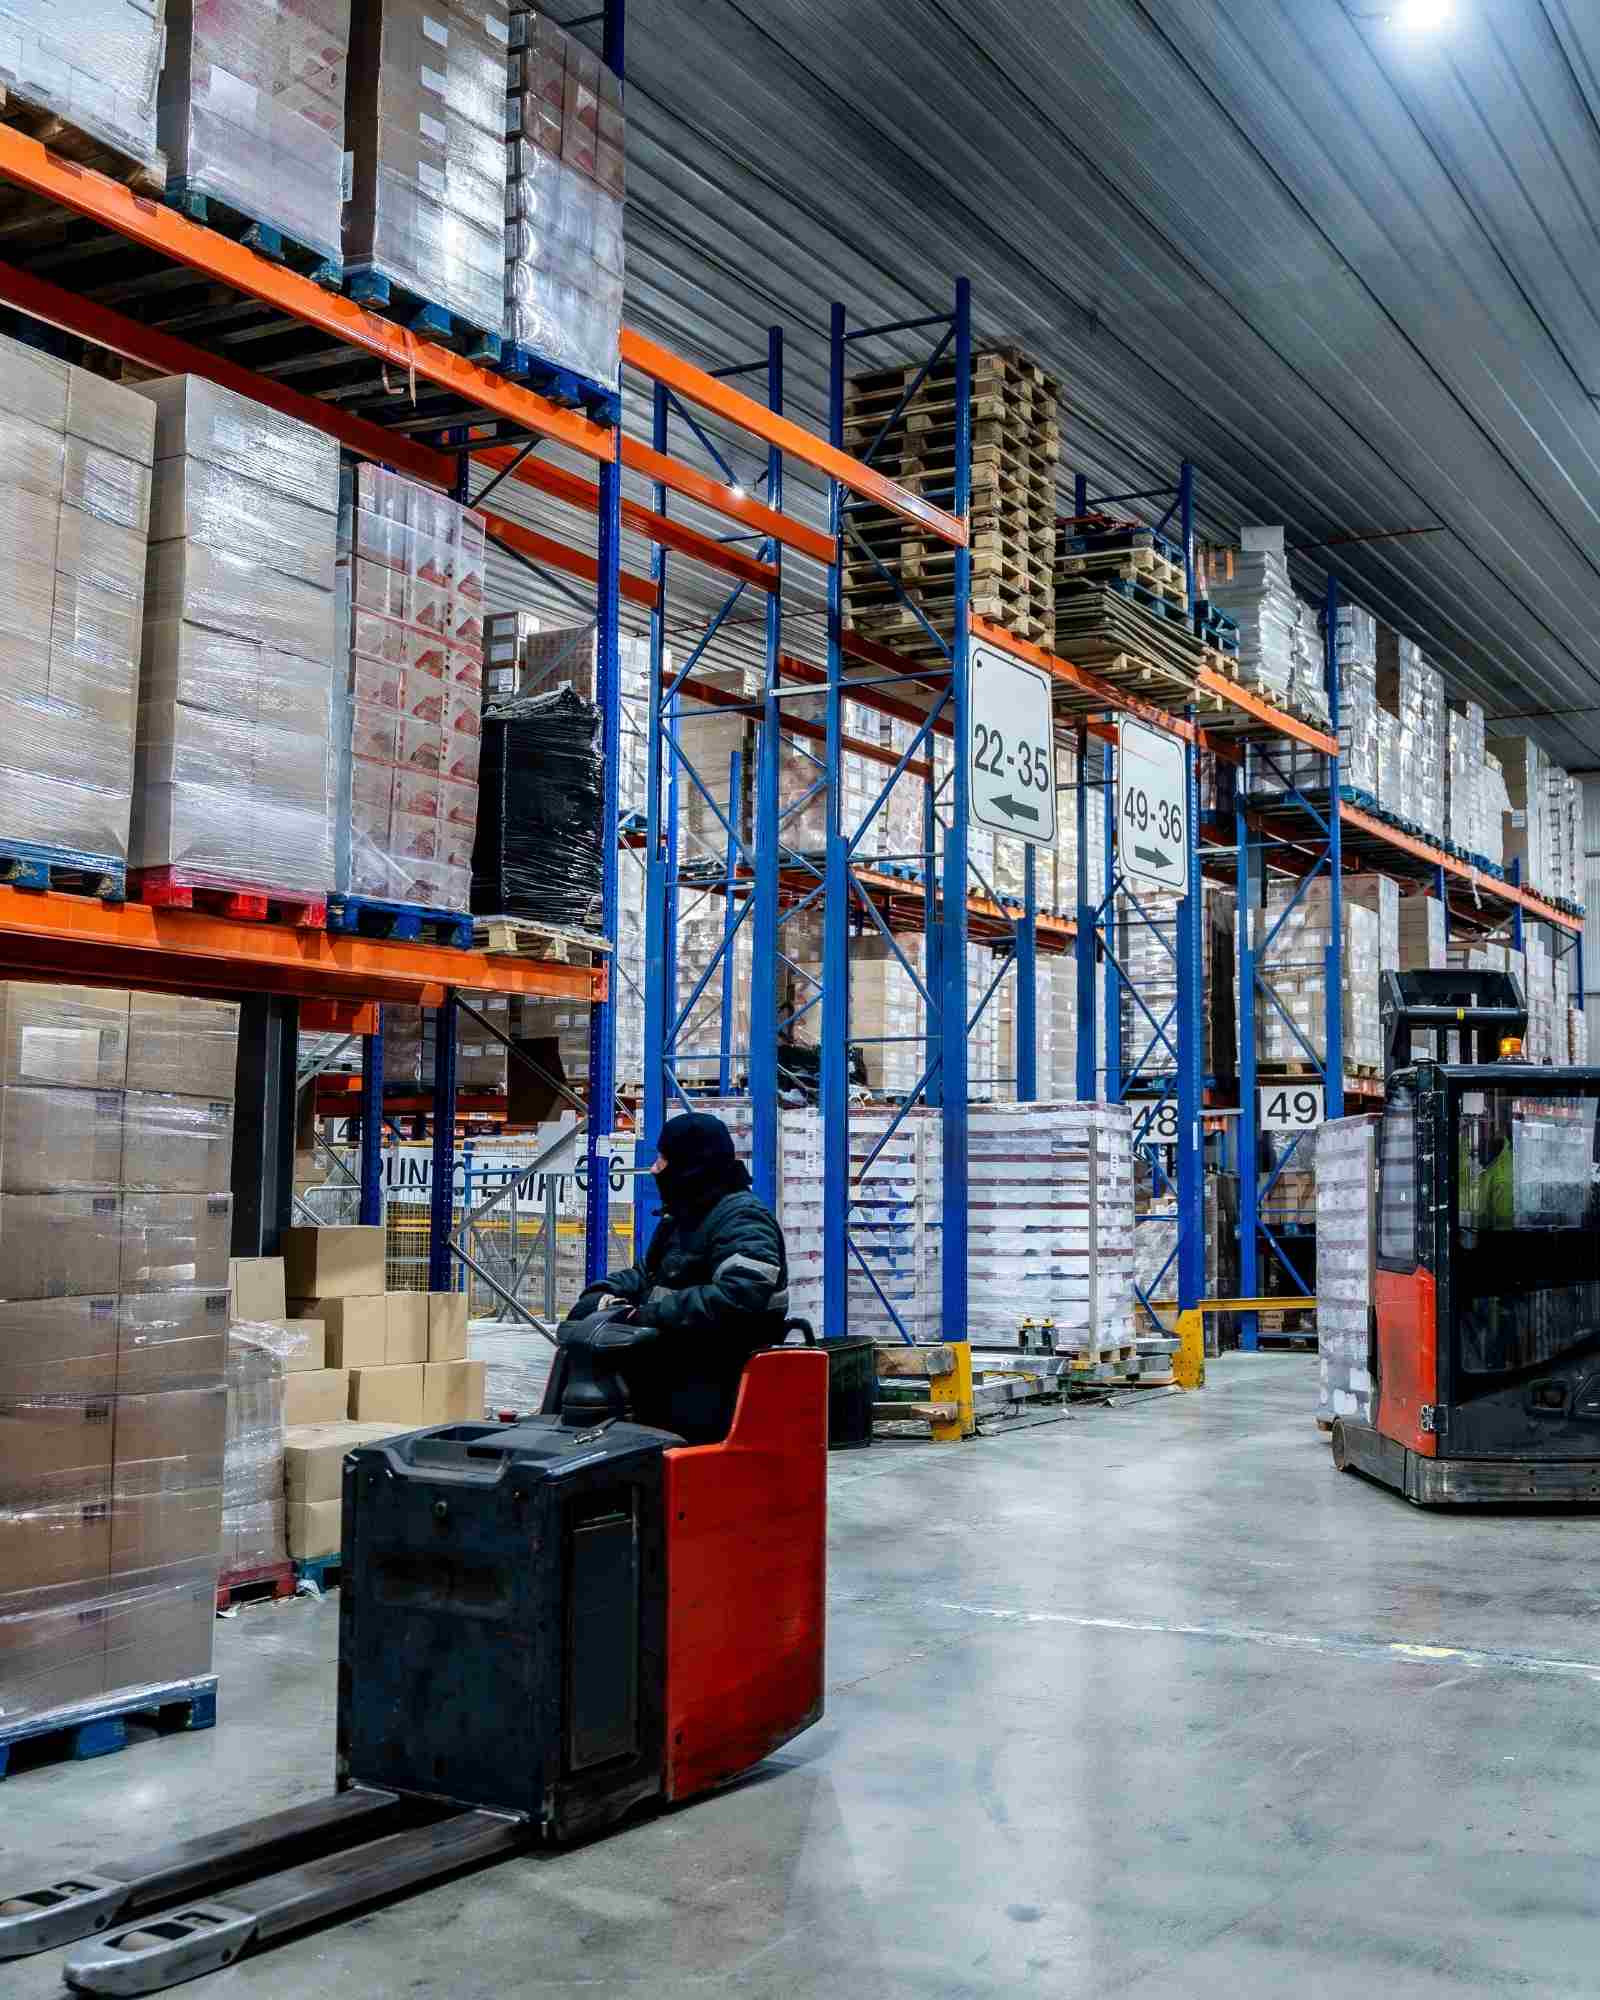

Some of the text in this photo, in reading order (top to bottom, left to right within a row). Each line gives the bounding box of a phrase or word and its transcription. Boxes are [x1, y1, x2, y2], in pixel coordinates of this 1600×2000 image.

[974, 723, 1049, 792] 22-35
[1124, 787, 1182, 844] 49-36
[1133, 1105, 1178, 1135] 48
[1266, 1091, 1317, 1124] 49
